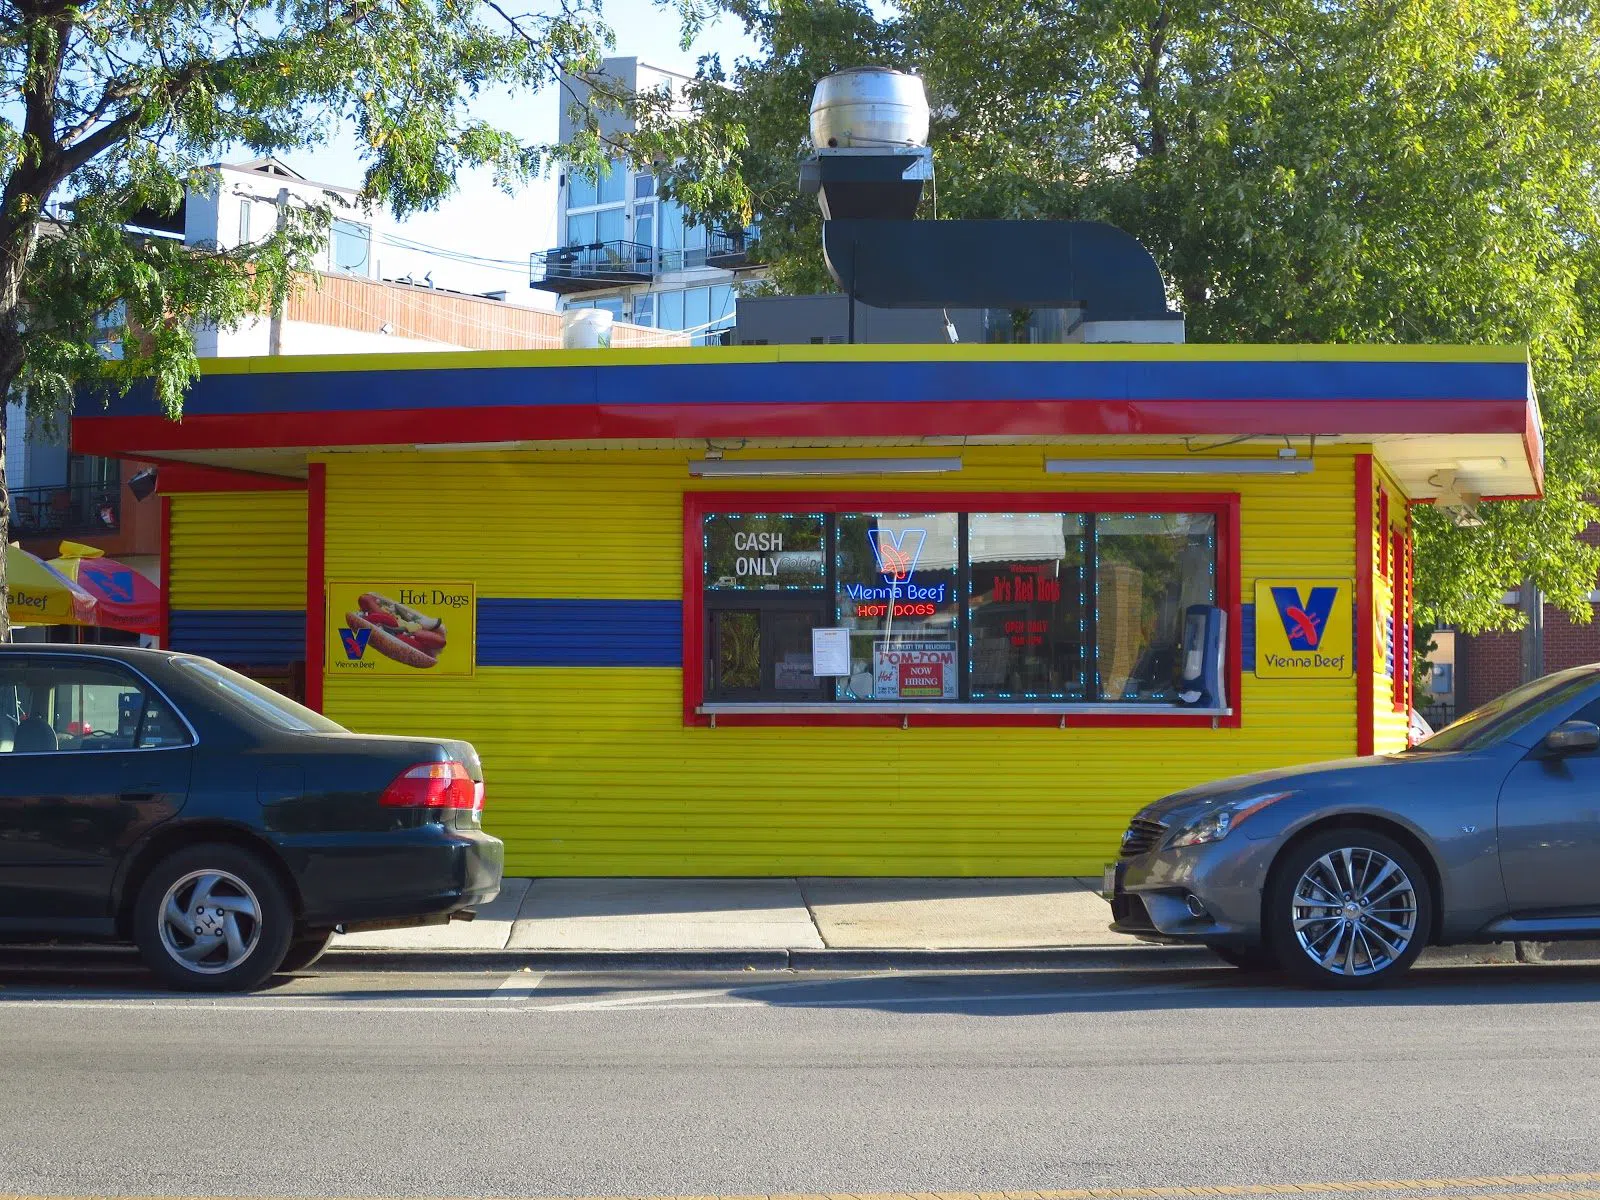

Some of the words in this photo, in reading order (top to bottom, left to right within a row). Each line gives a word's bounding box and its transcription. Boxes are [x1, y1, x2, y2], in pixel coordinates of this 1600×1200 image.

[734, 532, 783, 551] CASH
[735, 557, 780, 576] ONLY
[17, 591, 48, 611] Beef
[400, 590, 427, 605] Hot
[432, 590, 469, 609] Dogs
[907, 584, 945, 602] Beef
[858, 605, 888, 617] HOT
[894, 604, 935, 616] DOGS
[360, 661, 375, 669] Beef
[879, 651, 953, 665] TOM-TOM
[1265, 654, 1311, 668] Vienna
[1314, 654, 1345, 671] Beef
[910, 667, 932, 675] NOW
[904, 678, 938, 686] HIRING
